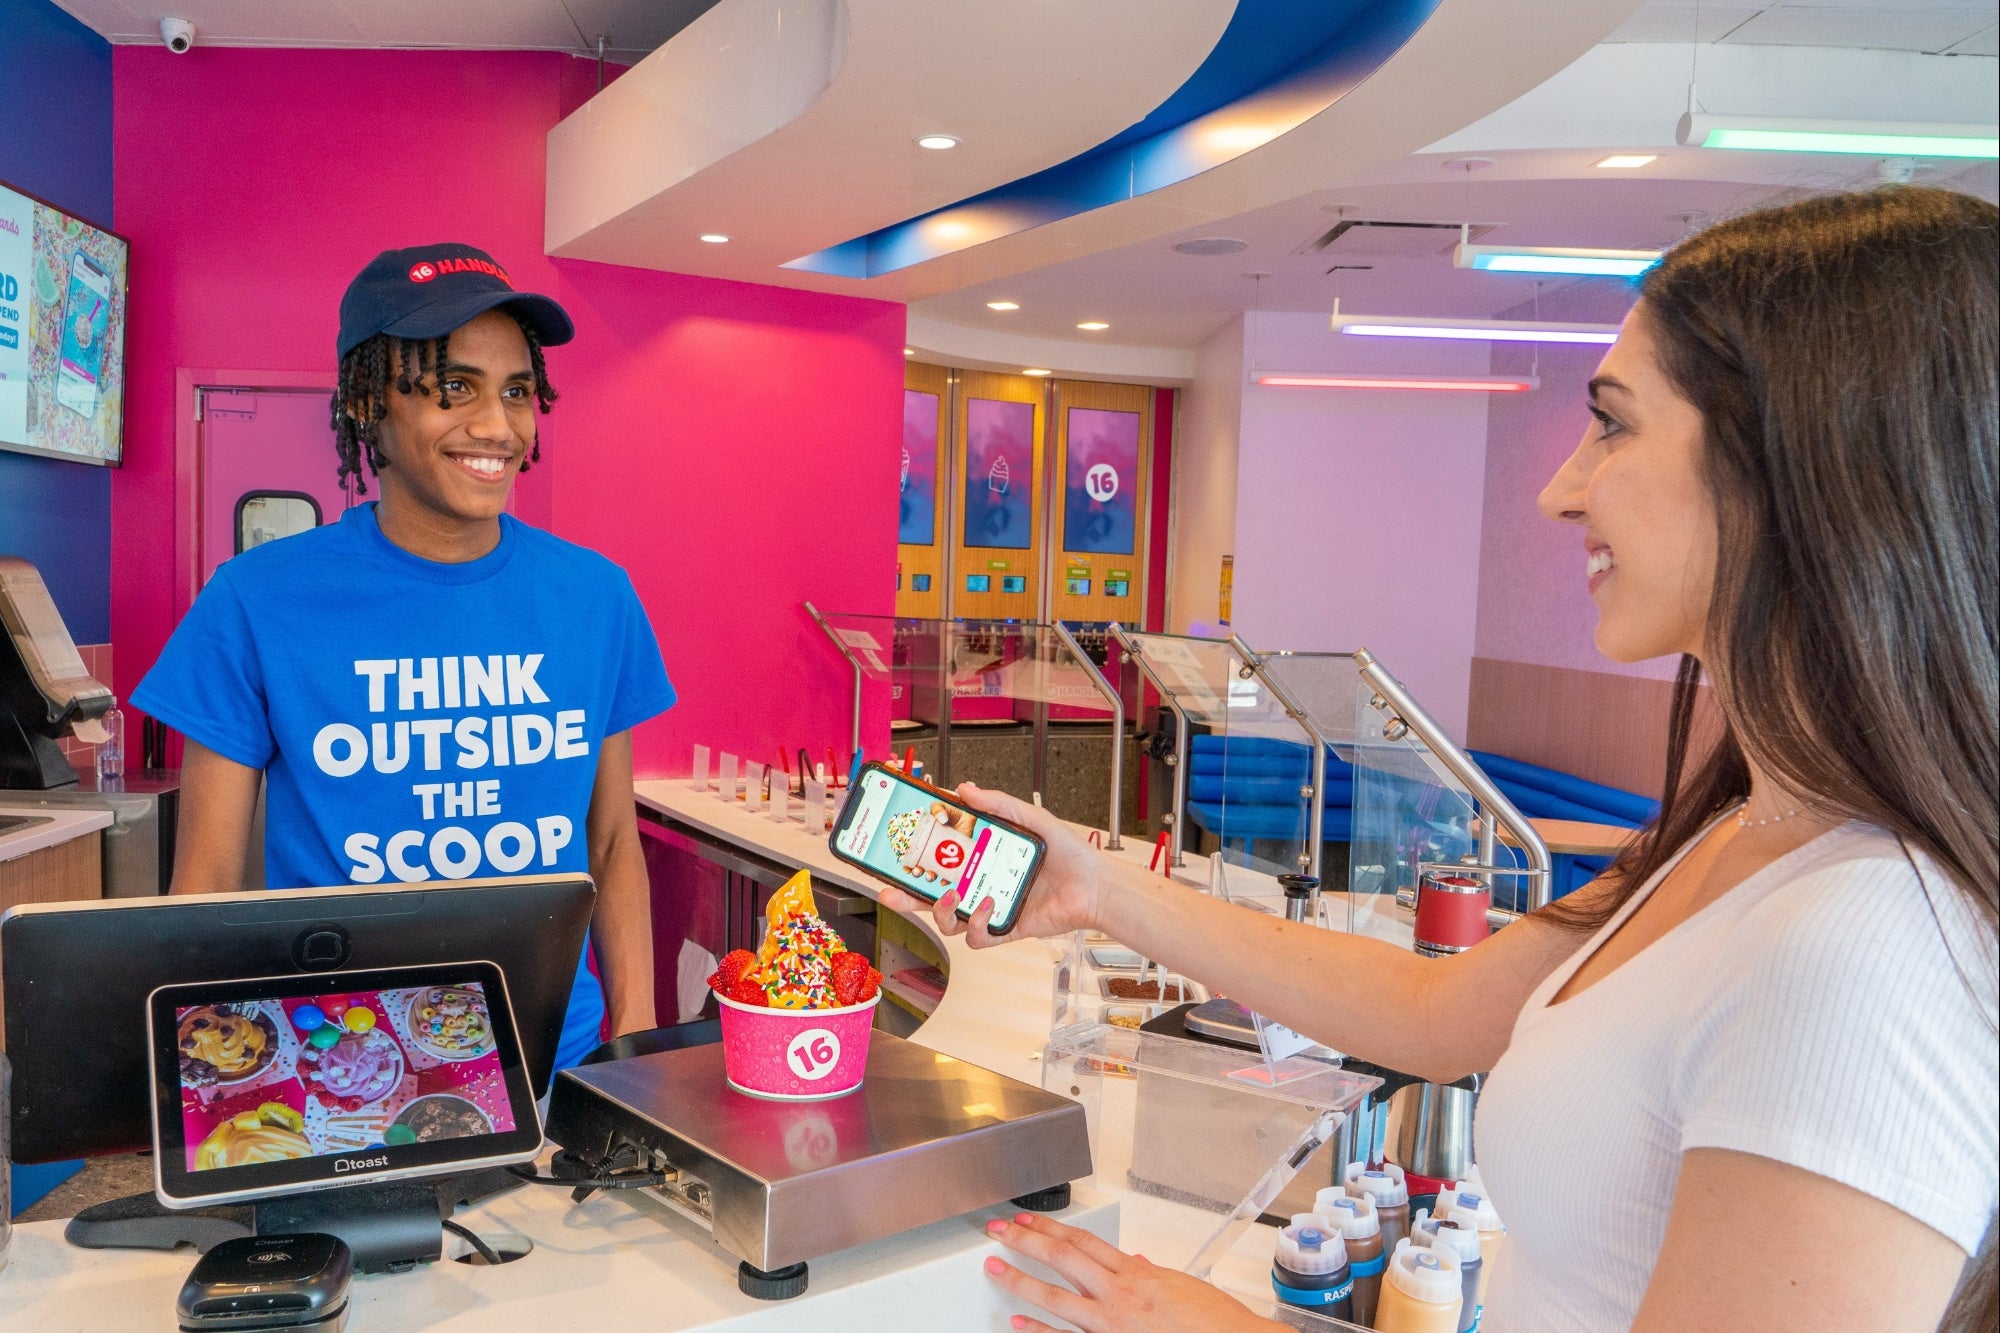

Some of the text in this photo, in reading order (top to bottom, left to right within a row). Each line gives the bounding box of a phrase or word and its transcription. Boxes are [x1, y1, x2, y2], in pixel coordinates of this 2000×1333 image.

[412, 265, 433, 280] 16
[1090, 472, 1115, 494] 16
[354, 653, 550, 712] THINK
[313, 709, 589, 777] OUTSIDE
[412, 779, 501, 820] THE
[344, 815, 573, 883] SCOOP
[940, 843, 959, 866] 16
[793, 1037, 834, 1073] 16
[349, 1155, 389, 1169] toast
